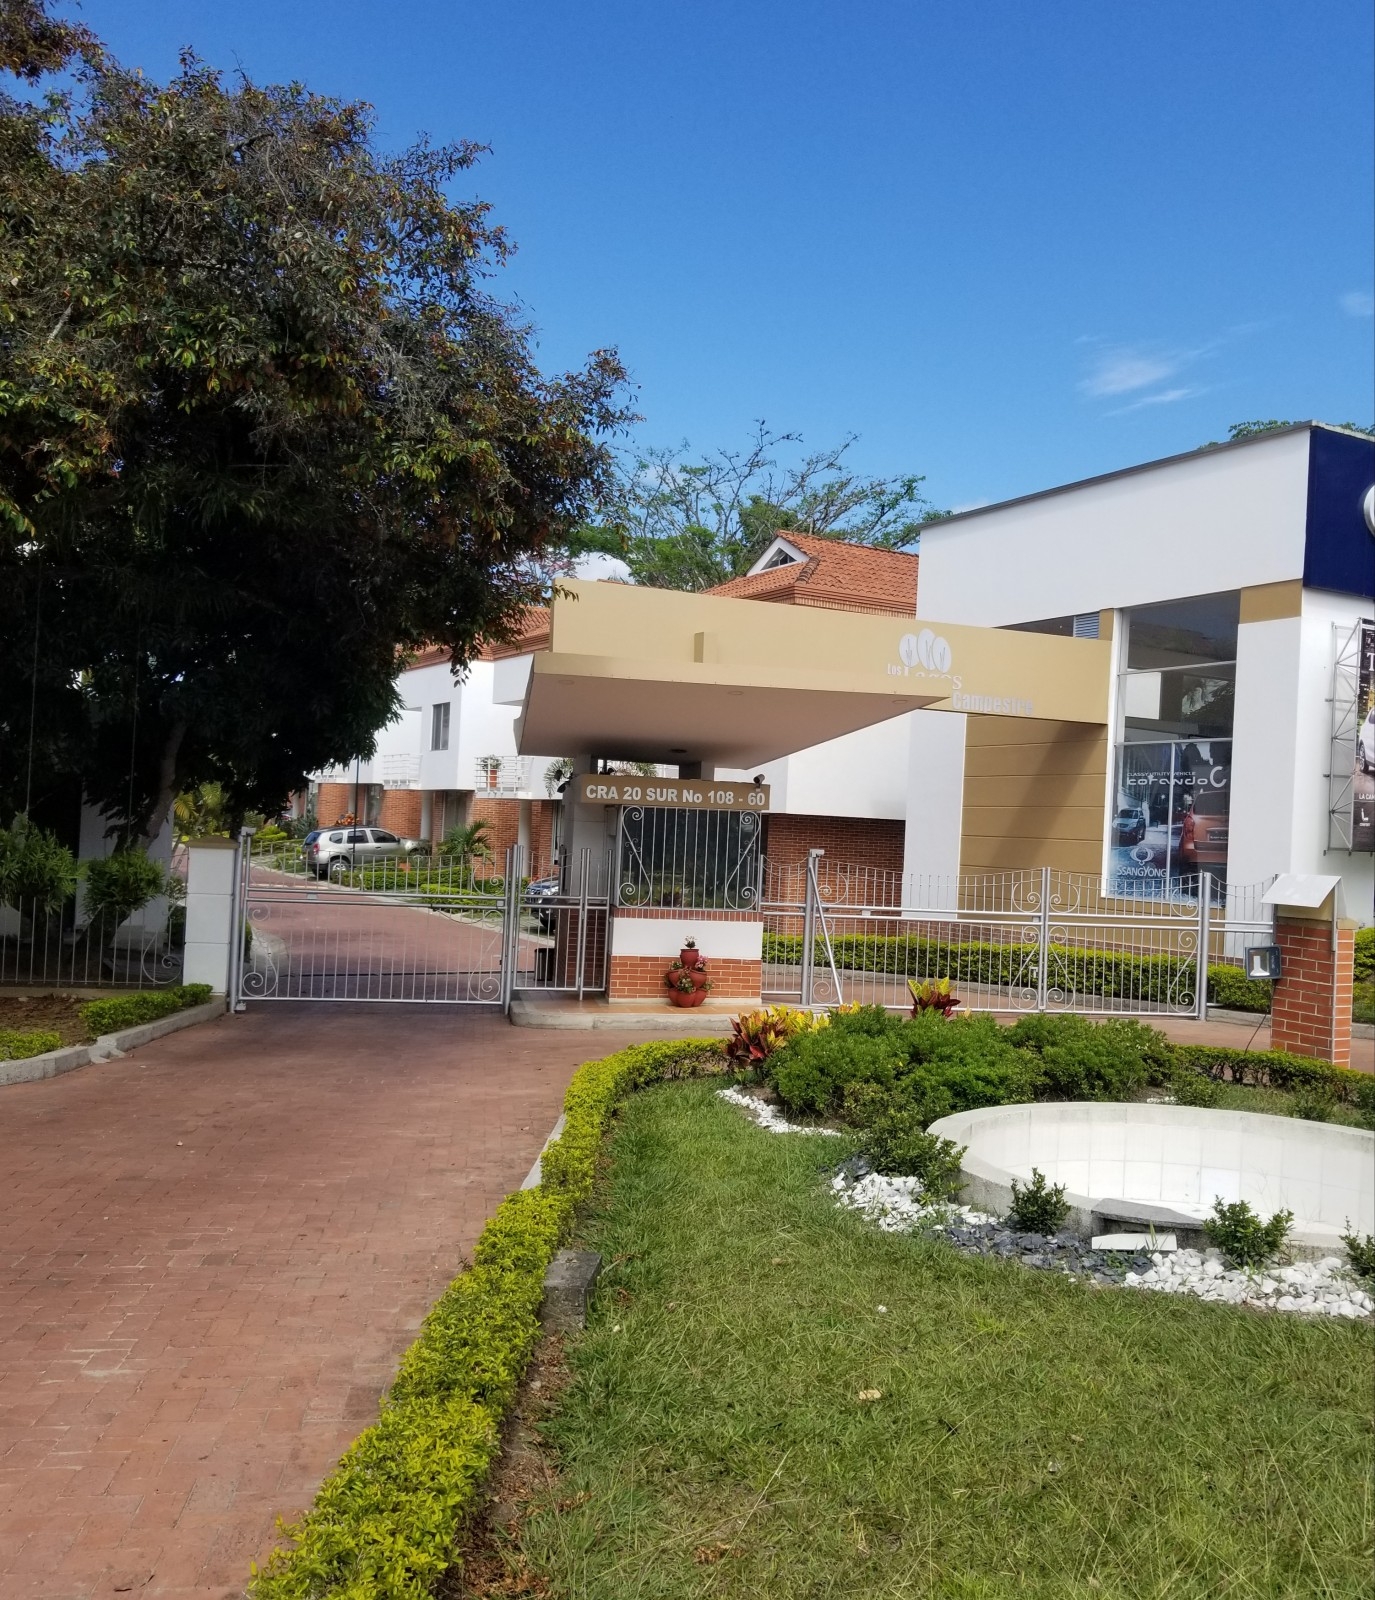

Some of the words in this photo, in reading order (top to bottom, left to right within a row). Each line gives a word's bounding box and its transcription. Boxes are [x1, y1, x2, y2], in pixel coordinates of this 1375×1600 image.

[952, 691, 1034, 716] Campestre
[586, 785, 618, 800] CRA
[623, 786, 642, 801] 20
[645, 787, 678, 802] SUR
[682, 789, 703, 804] No
[707, 790, 734, 805] 108
[747, 792, 765, 806] 60
